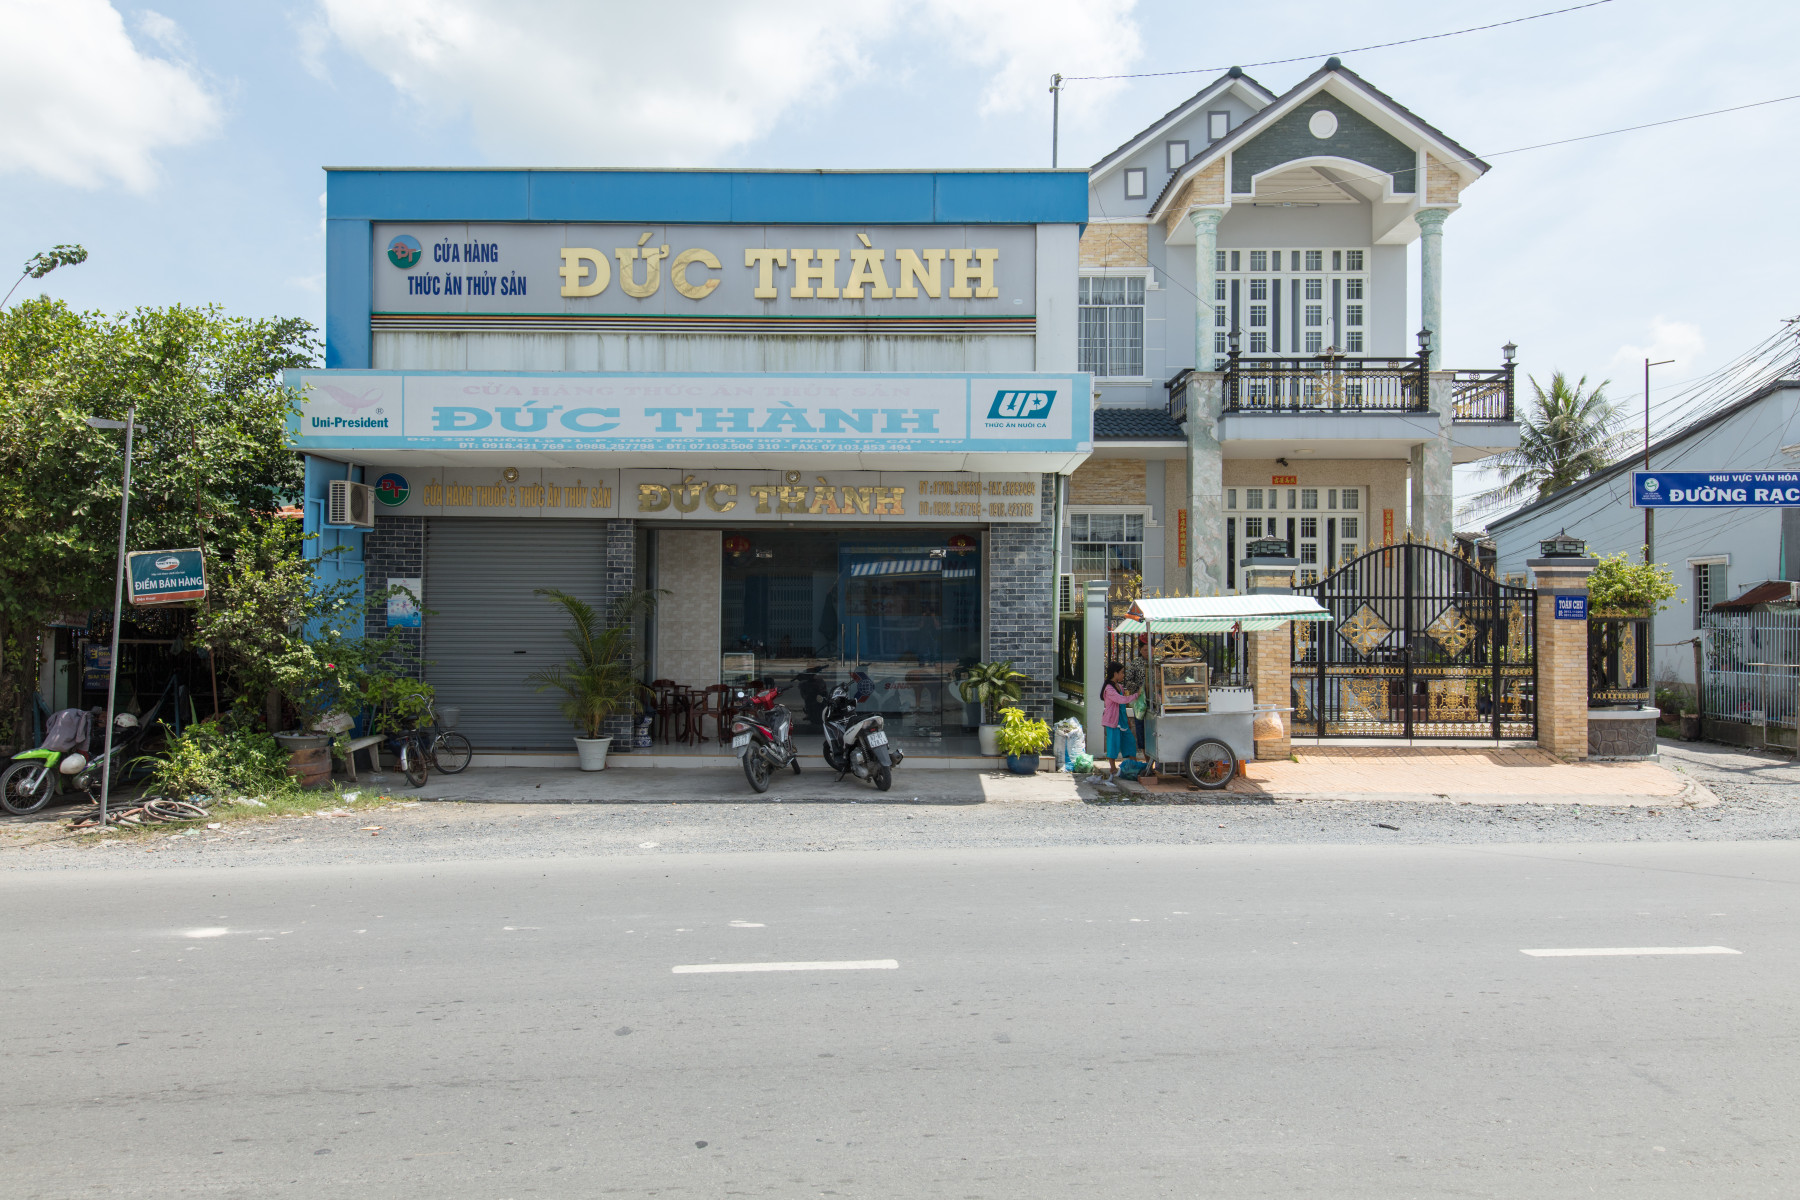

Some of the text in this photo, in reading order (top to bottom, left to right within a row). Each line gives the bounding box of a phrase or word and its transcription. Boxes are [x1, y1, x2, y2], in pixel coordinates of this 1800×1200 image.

[433, 237, 498, 263] CỬA HÀNG
[560, 232, 999, 299] ĐỨC THÀNH
[408, 270, 527, 295] THỨC ĂN THỦY SẢN
[462, 382, 521, 396] CỬA
[531, 383, 614, 397] HÀNG
[624, 383, 704, 397] THỨC
[852, 384, 911, 397] SẢN
[311, 416, 389, 428] Uni-President
[432, 400, 940, 434] ĐỨC THÀNH
[381, 479, 402, 498] ĐT
[1732, 474, 1752, 483] VỰC
[1755, 474, 1775, 482] VĂN
[1777, 474, 1798, 482] HÓA
[423, 478, 611, 509] CỬA HÀNG THUỐC & THỨC ĂN THỦY SẢN
[638, 474, 905, 515] ĐỨC THÀNH
[1668, 485, 1747, 502] ĐƯỜNG
[135, 576, 202, 590] ĐIỂM BÁN HÀNG
